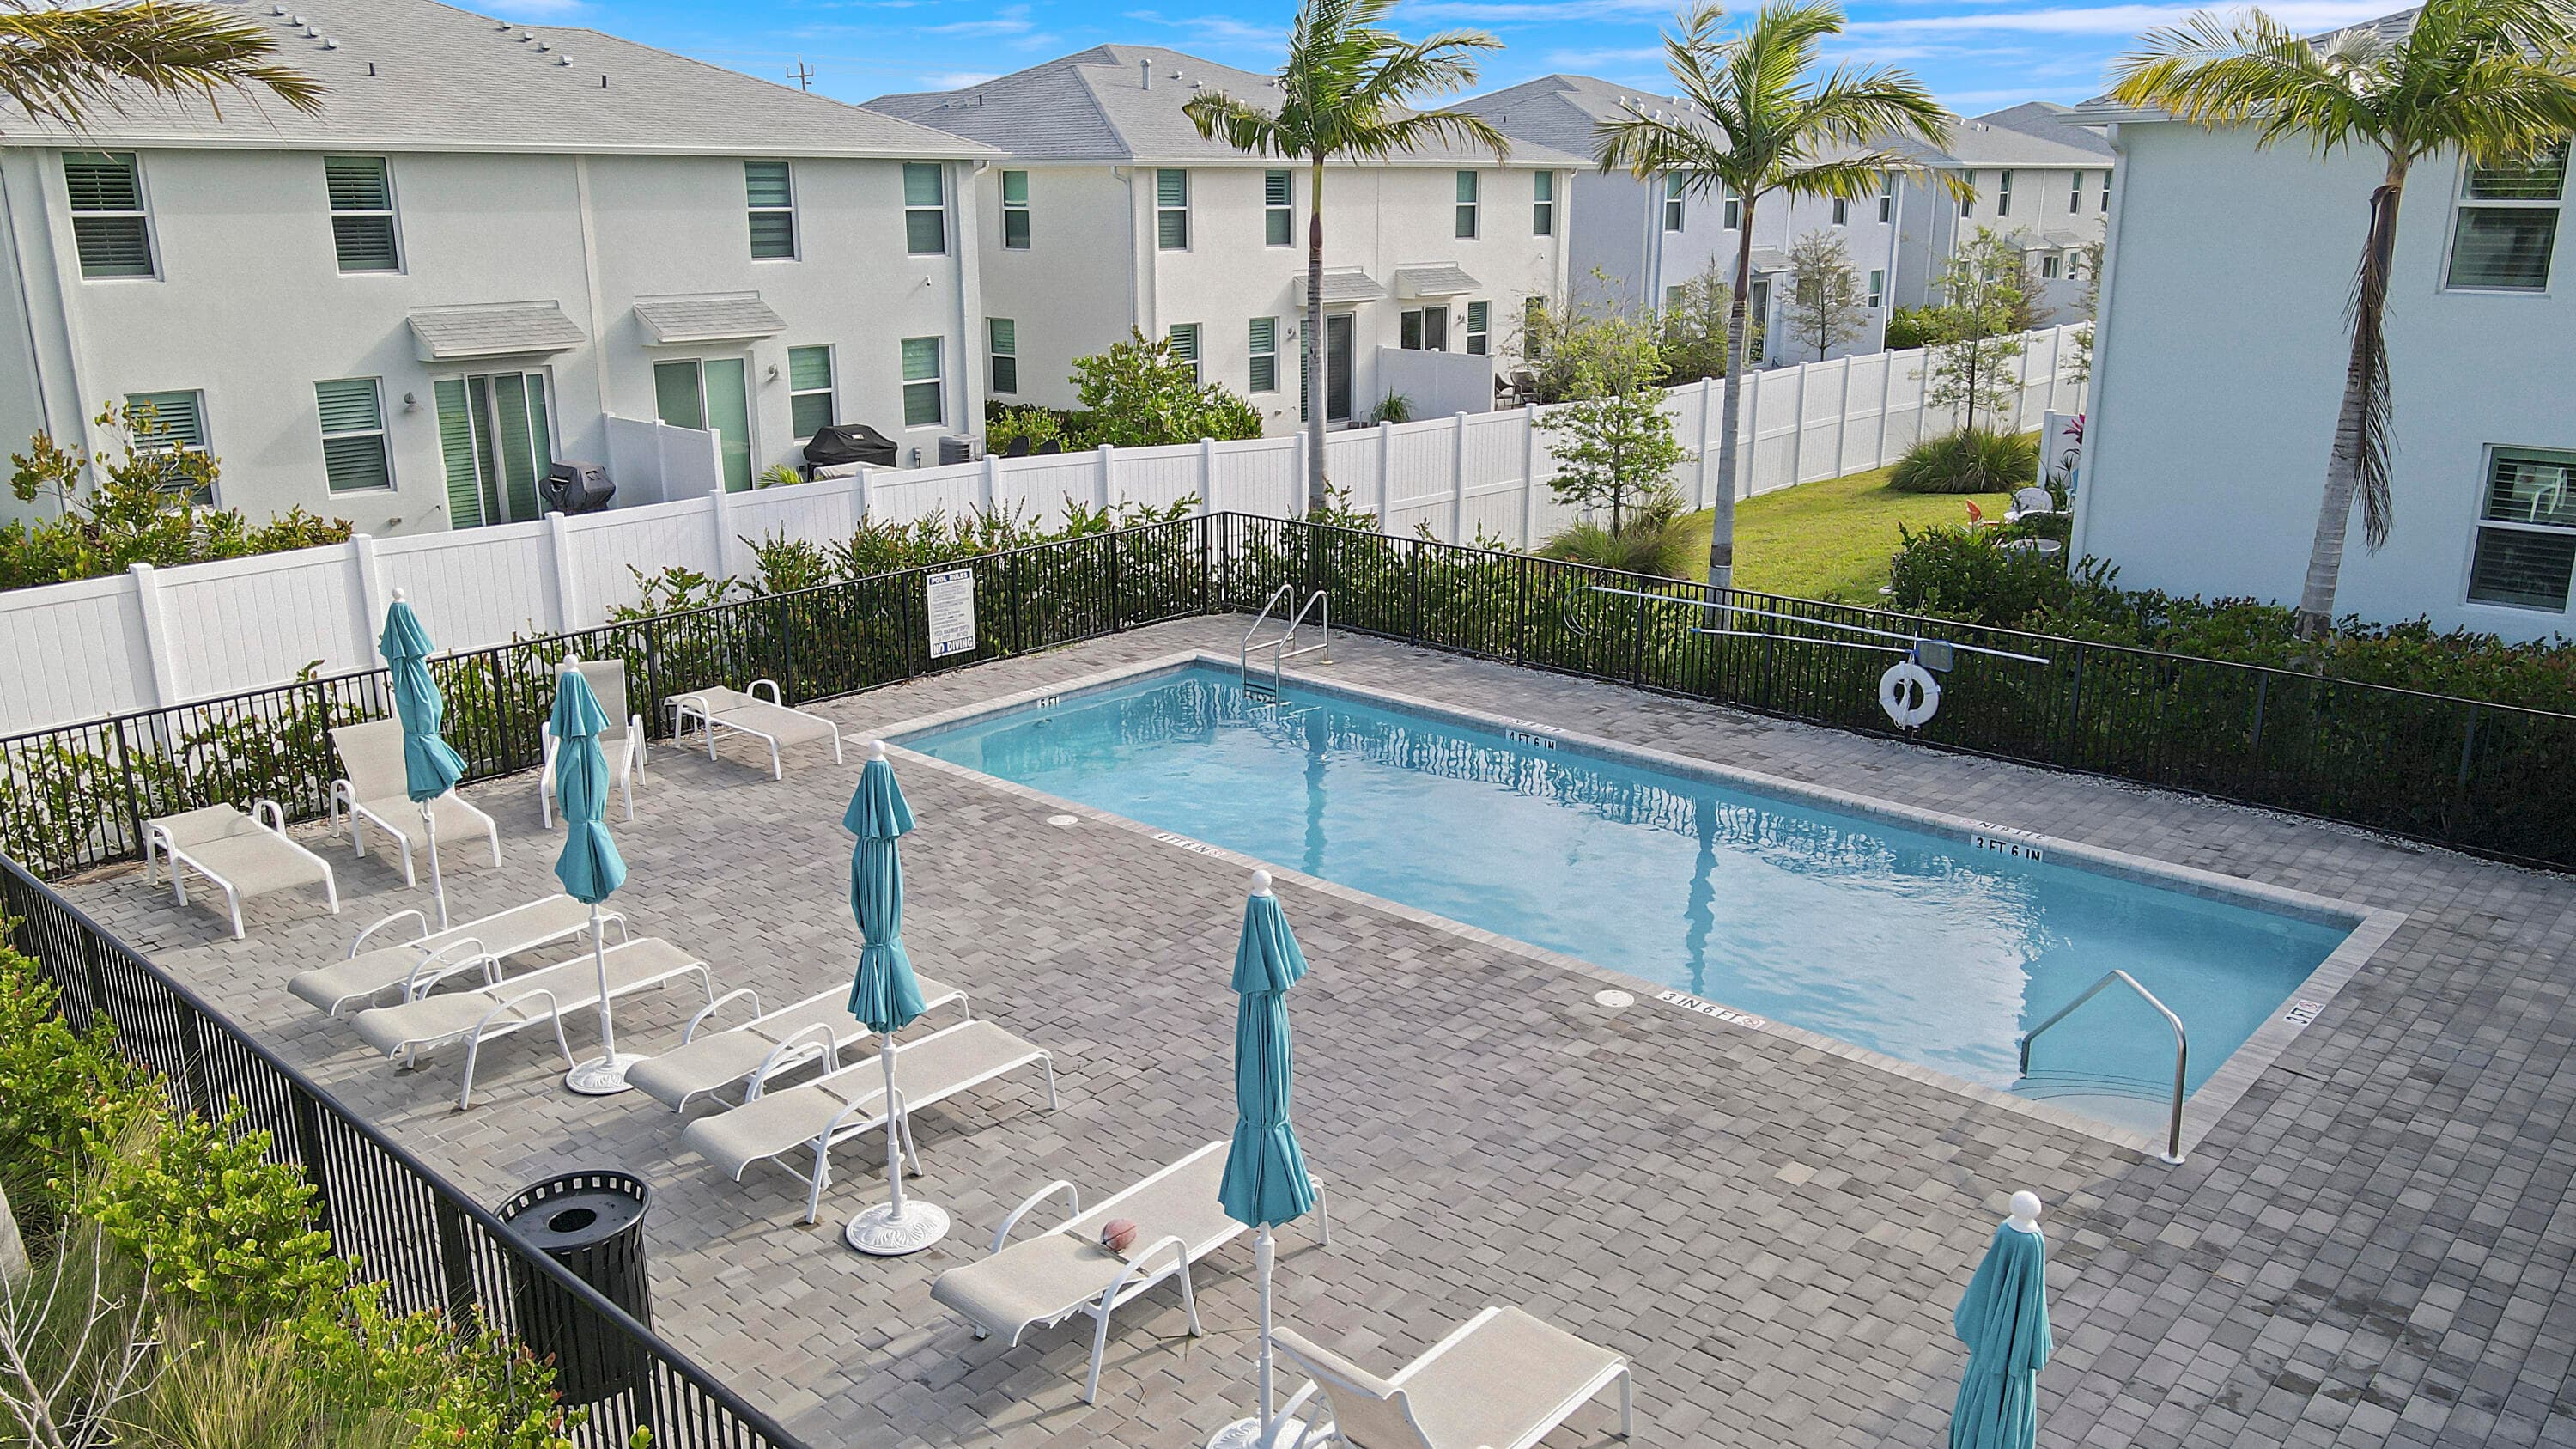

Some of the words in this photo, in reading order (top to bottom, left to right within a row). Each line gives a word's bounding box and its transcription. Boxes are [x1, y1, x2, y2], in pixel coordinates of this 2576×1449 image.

[932, 575, 947, 584] POOL
[950, 572, 968, 581] RULES
[933, 642, 945, 654] NO
[947, 637, 973, 651] DIVING
[1048, 696, 1059, 707] FT
[1519, 733, 1530, 745] FT
[1545, 740, 1554, 750] IN
[1976, 837, 1984, 849] 3
[1989, 840, 2006, 854] FT
[2011, 845, 2019, 856] 6
[2026, 849, 2041, 861] IN
[1677, 997, 1701, 1008] IN
[1716, 1010, 1743, 1021] FT
[2290, 1007, 2317, 1020] FT
[2286, 1016, 2308, 1025] 3
